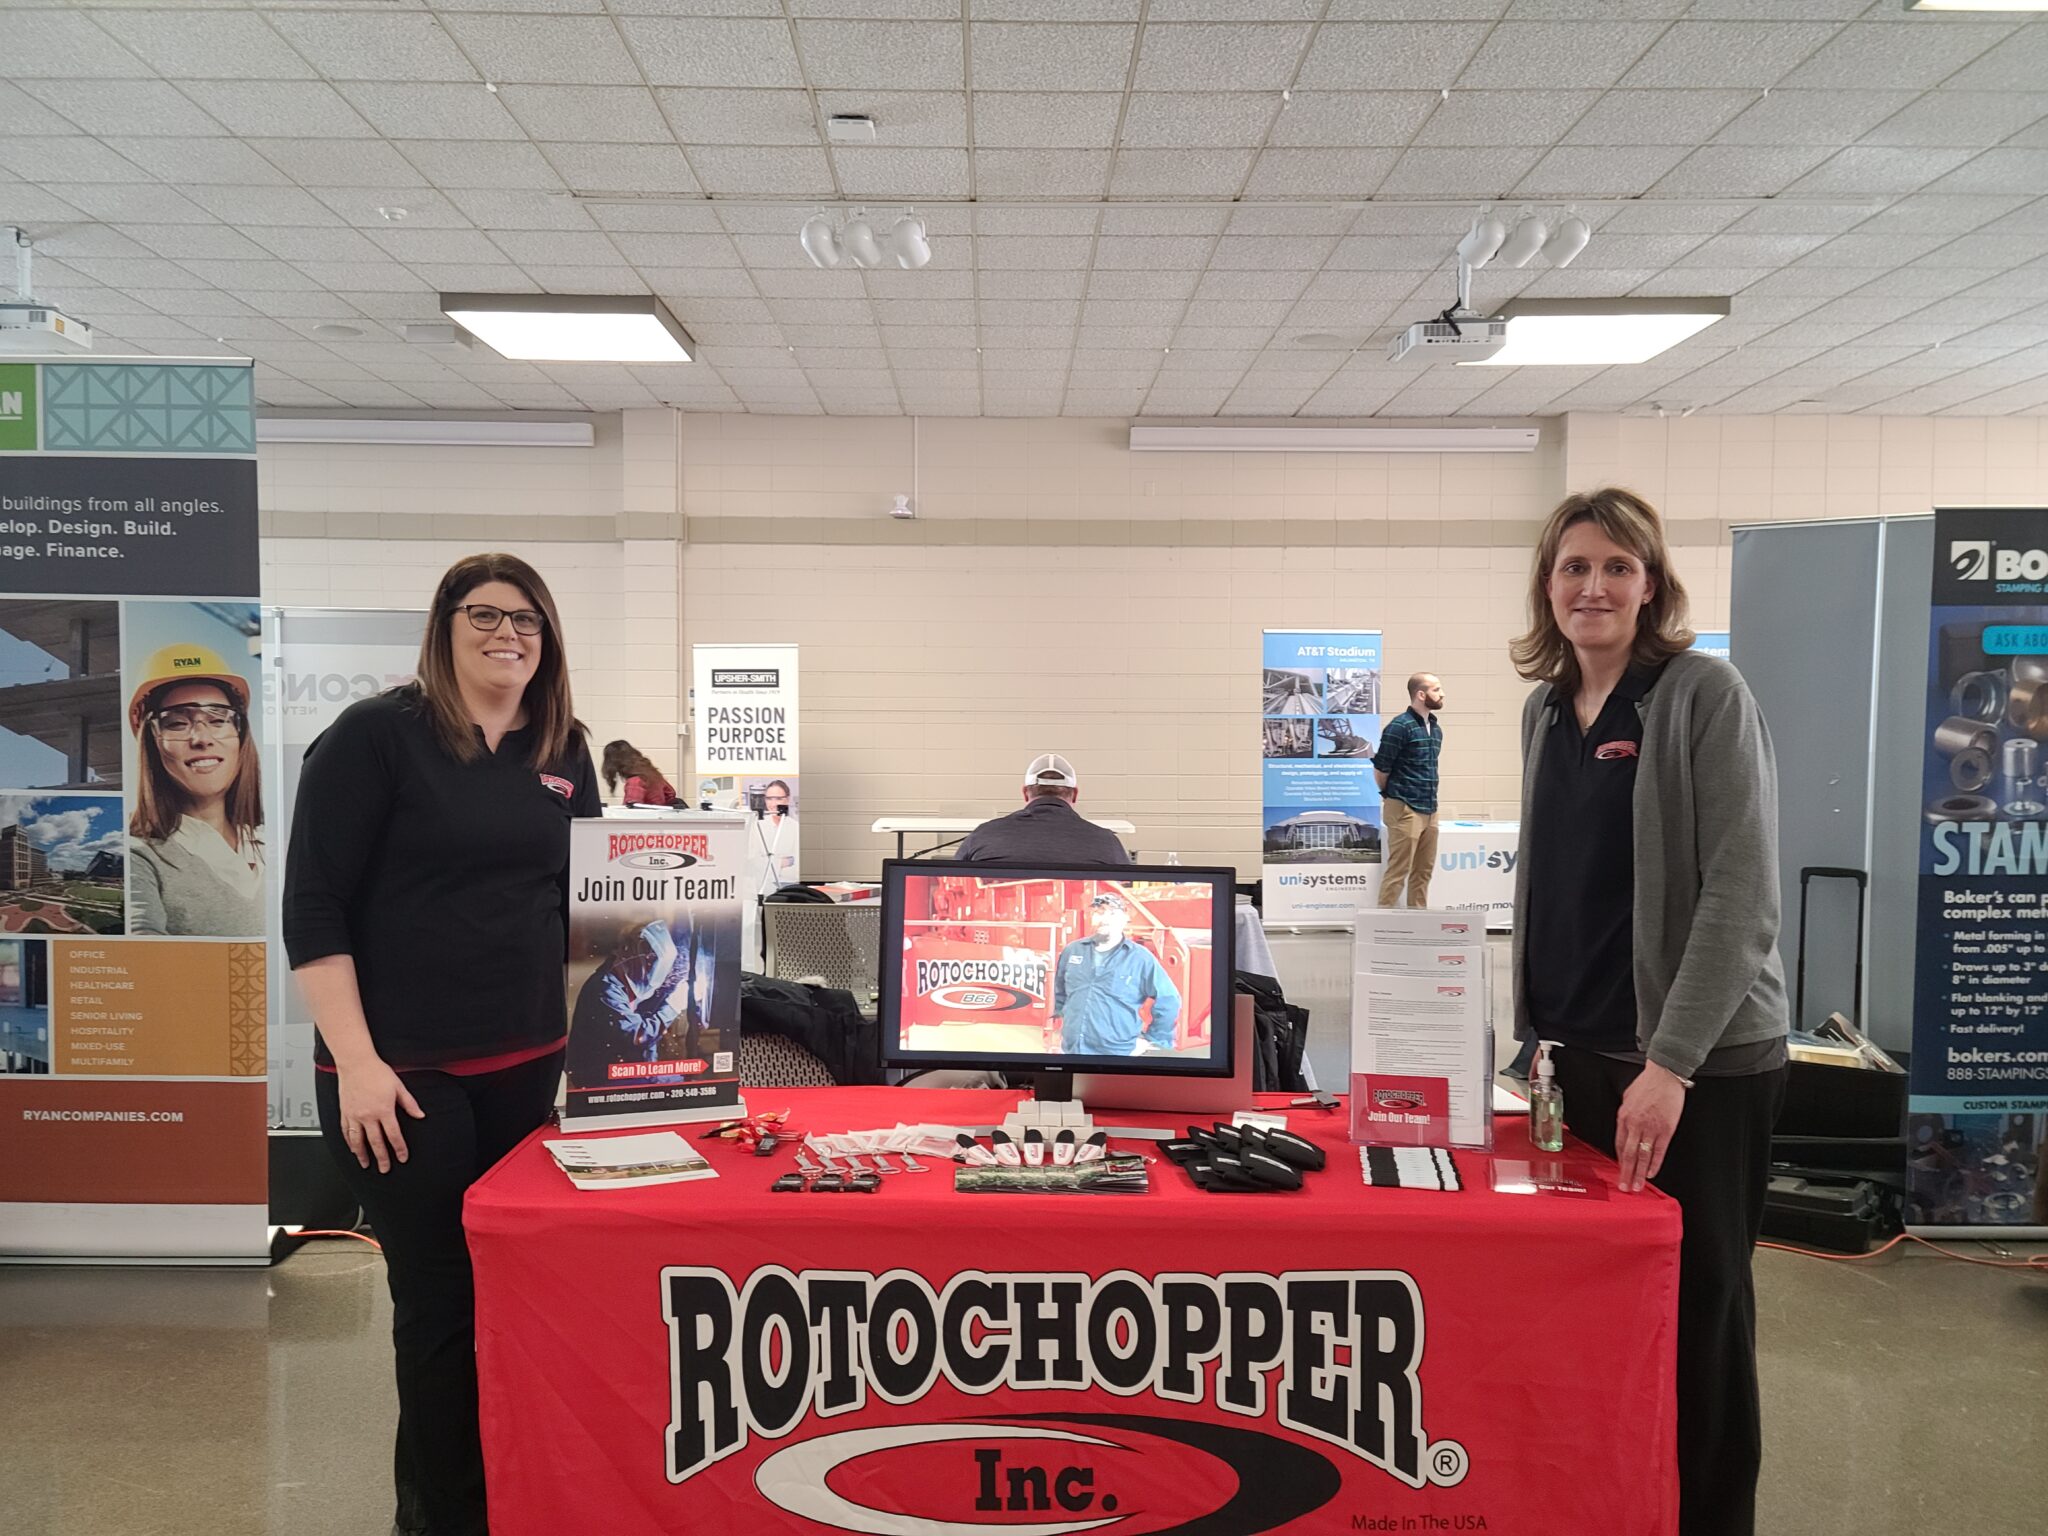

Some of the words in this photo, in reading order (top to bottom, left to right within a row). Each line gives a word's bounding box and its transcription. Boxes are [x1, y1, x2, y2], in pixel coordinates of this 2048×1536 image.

[0, 391, 23, 415] N
[3, 496, 83, 515] buildings
[88, 497, 128, 512] from
[134, 497, 155, 512] all
[161, 498, 225, 517] angles.
[49, 519, 118, 538] Design.
[124, 520, 177, 535] Build.
[0, 545, 41, 560] age.
[46, 542, 125, 558] Finance.
[1995, 633, 2018, 648] ASK
[1298, 646, 1326, 657] AT&T
[1327, 646, 1377, 657] Stadium
[174, 658, 201, 668] RYAN
[714, 674, 777, 684] UPSHER-SMITH
[707, 706, 786, 725] PASSION
[707, 727, 787, 744] PURPOSE
[707, 746, 788, 762] POTENTIAL
[608, 833, 709, 862] ROTOCHOPPER
[1933, 821, 2048, 876] STAM
[649, 856, 669, 866] Inc.
[1440, 845, 1518, 873] unisy
[1280, 872, 1367, 888] unisystems
[577, 875, 625, 902] Join
[632, 876, 669, 901] Our
[674, 875, 736, 901] Team!
[1944, 889, 2004, 904] Boker's
[2008, 893, 2037, 904] can
[1943, 905, 2012, 922] complex
[1953, 930, 1986, 941] Metal
[1988, 930, 2032, 942] forming
[2034, 930, 2046, 941] in
[69, 950, 106, 960] OFFICE
[1953, 944, 1980, 953] from
[2016, 945, 2031, 955] up
[2033, 944, 2046, 953] to
[69, 966, 129, 976] INDUSTRIAL
[1952, 962, 1989, 972] Draws
[1991, 963, 2007, 974] up
[2008, 962, 2021, 971] to
[69, 981, 135, 991] HEALTHCARE
[916, 960, 1048, 1000] ROTOCHOPPER
[1968, 976, 1979, 985] in
[1981, 975, 2031, 985] diameter
[69, 996, 104, 1006] RETAIL
[1951, 993, 1973, 1003] Flat
[1975, 993, 2024, 1005] blanking
[69, 1011, 108, 1021] SENIOR
[110, 1012, 144, 1022] LIVING
[1951, 1007, 1966, 1018] up
[1968, 1006, 1981, 1016] to
[2005, 1006, 2021, 1018] by
[70, 1027, 135, 1036] HOSPITALITY
[1950, 1024, 1974, 1034] Fast
[1976, 1024, 2025, 1036] delivery!
[71, 1042, 126, 1051] MIXED-USE
[71, 1057, 135, 1067] MULTIFAMILY
[611, 1065, 635, 1078] Scan
[636, 1064, 647, 1075] To
[647, 1063, 674, 1075] Learn
[675, 1060, 702, 1073] More!
[587, 1091, 665, 1104] www.rotochopper.com
[1373, 1089, 1425, 1106] ROTOCHOPPER
[1963, 1100, 2009, 1110] CUSTOM
[23, 1109, 184, 1123] RYANCOMPANIES.COM
[1367, 1110, 1387, 1122] Join
[1388, 1111, 1404, 1123] Our
[1404, 1112, 1431, 1125] Team!
[661, 1265, 1428, 1489] ROTOCHOPPER
[974, 1449, 1119, 1513] Inc.
[1352, 1514, 1398, 1531] Made
[1401, 1515, 1416, 1530] In
[1419, 1512, 1449, 1530] The
[1454, 1515, 1488, 1531] USA
